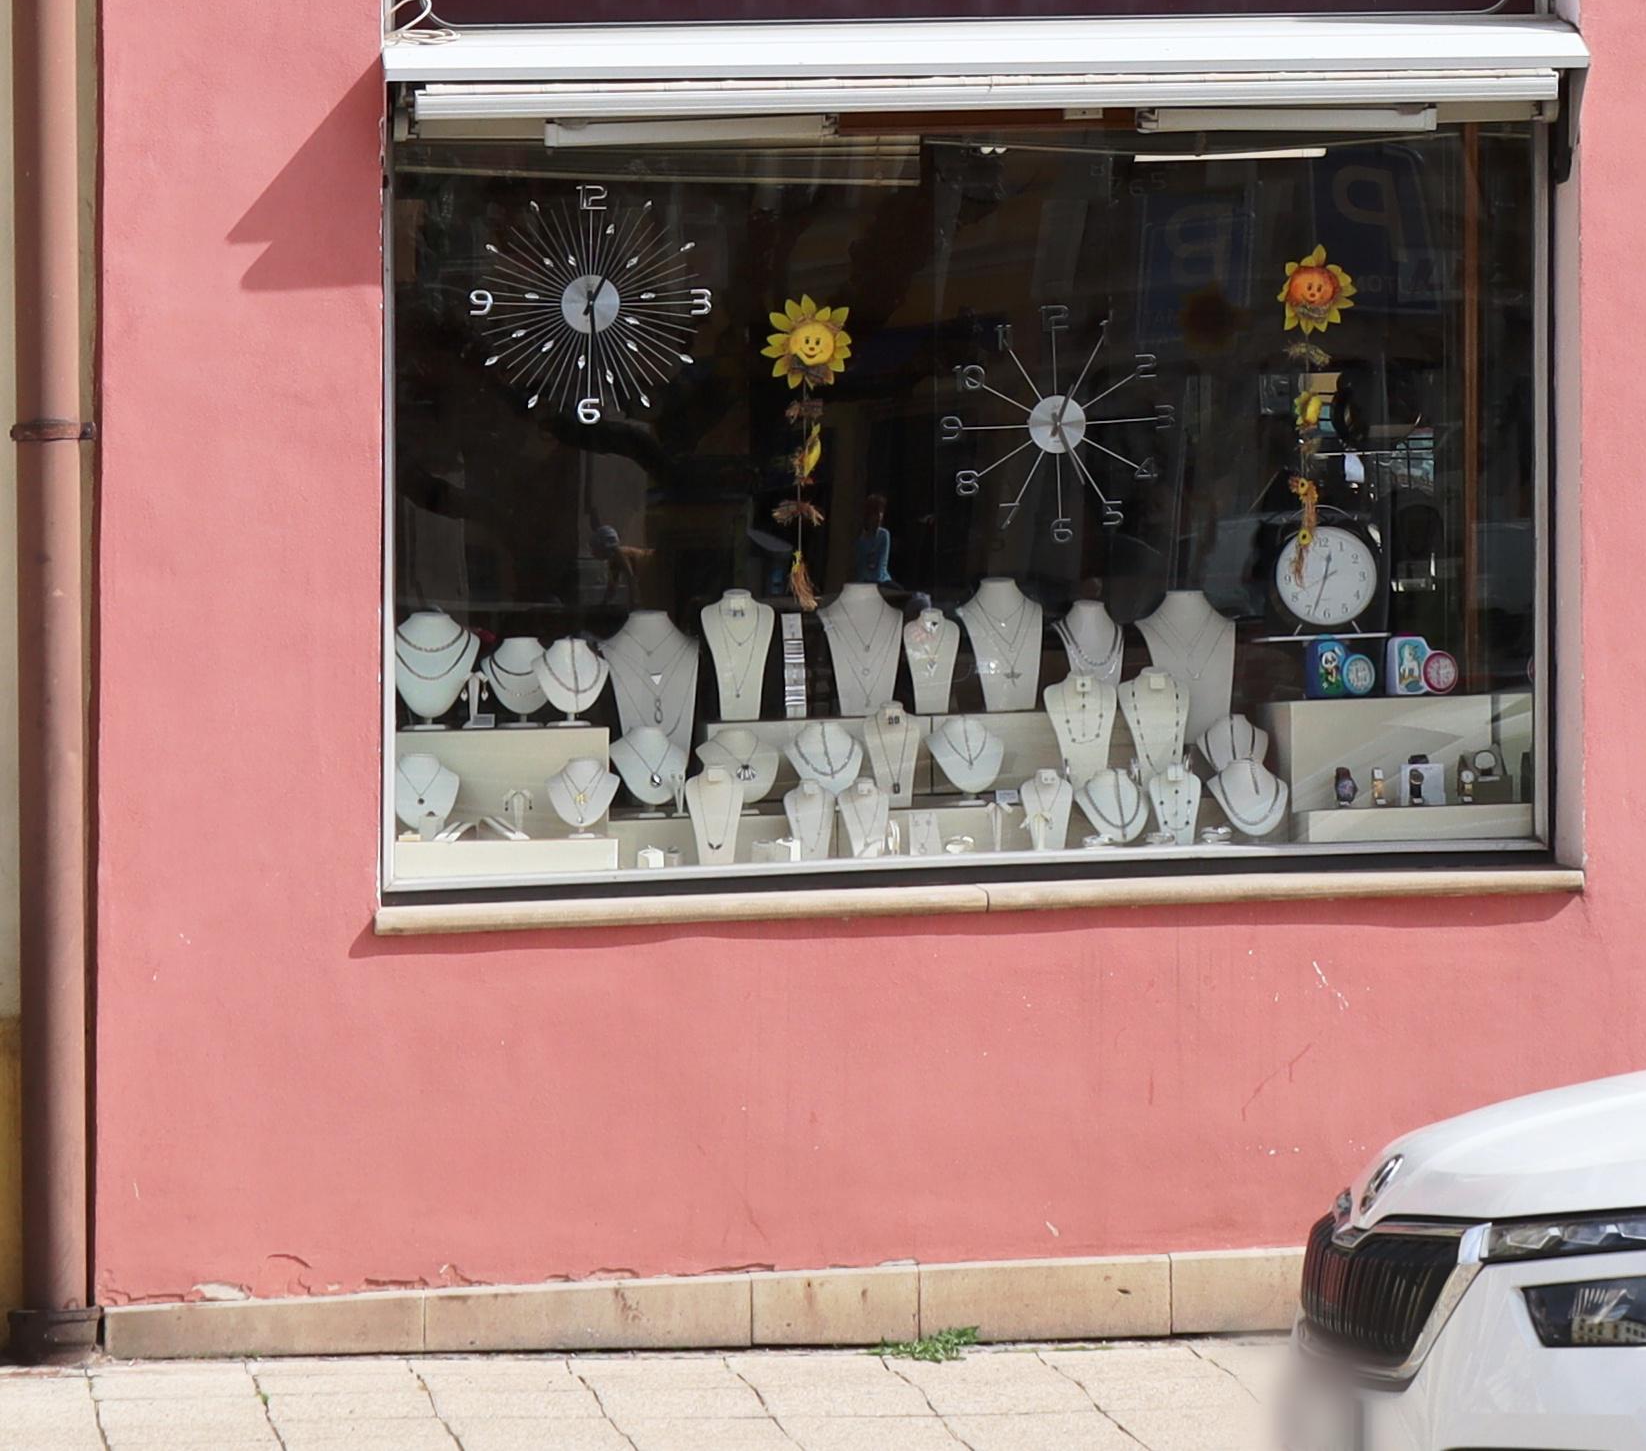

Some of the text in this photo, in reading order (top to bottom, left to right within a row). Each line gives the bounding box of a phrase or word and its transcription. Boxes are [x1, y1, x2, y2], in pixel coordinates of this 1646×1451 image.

[575, 185, 608, 211] 12
[469, 288, 494, 316] 9
[689, 288, 713, 316] 3
[1039, 305, 1070, 332] 12
[952, 364, 986, 390] 10
[1134, 353, 1158, 378] 2
[576, 397, 602, 425] 6
[1154, 404, 1176, 430] 3
[939, 415, 964, 441] 9
[1134, 456, 1159, 480] 4
[955, 469, 980, 496] 8
[998, 502, 1021, 530] 7
[1102, 500, 1125, 526] 5
[1050, 517, 1074, 543] 6
